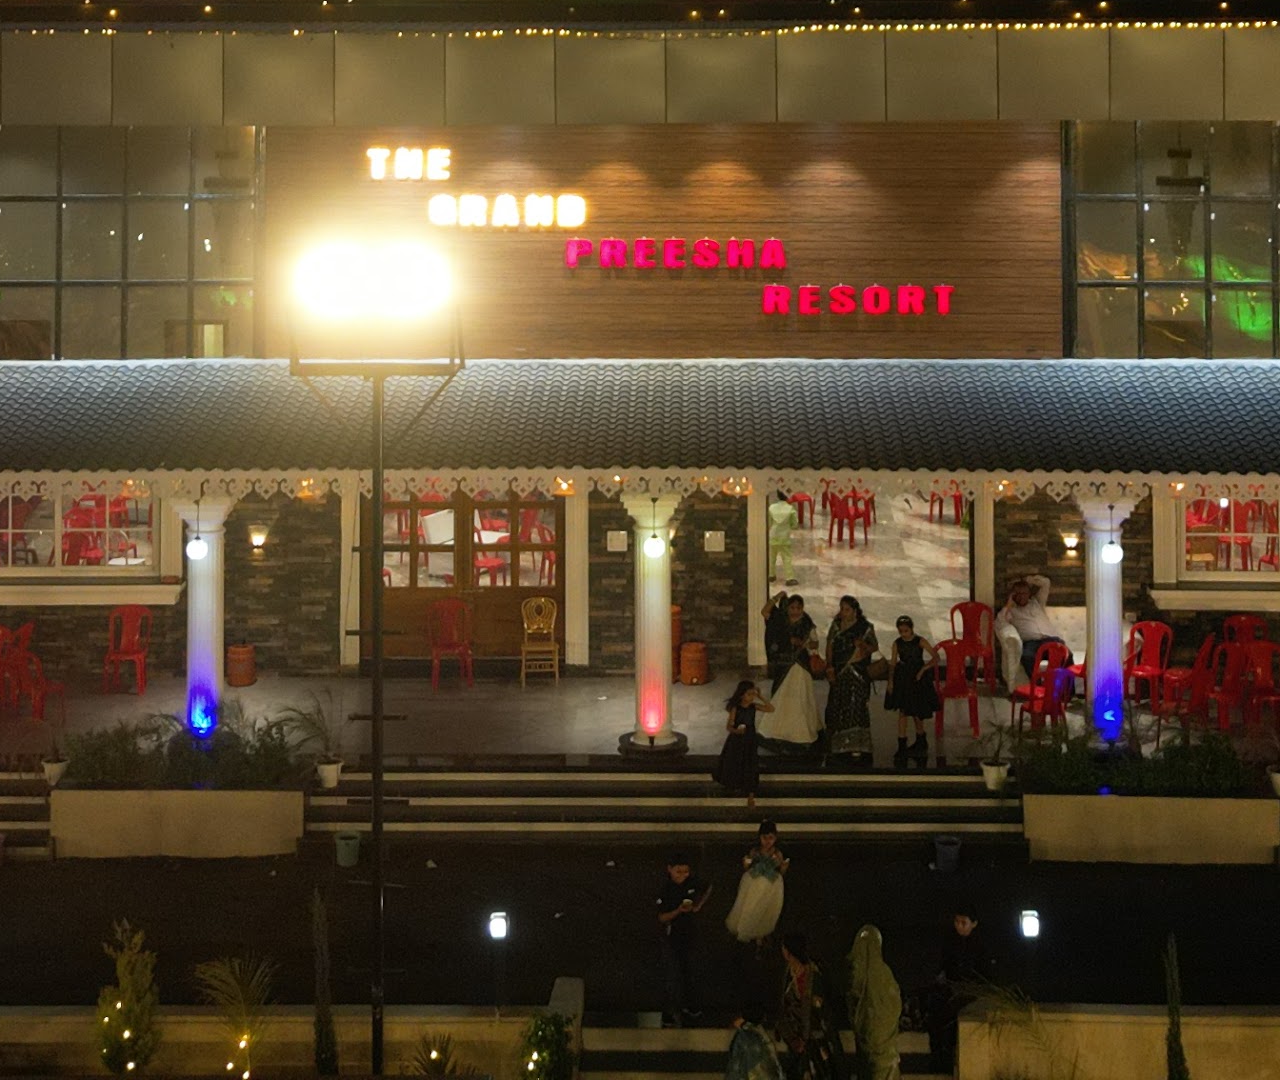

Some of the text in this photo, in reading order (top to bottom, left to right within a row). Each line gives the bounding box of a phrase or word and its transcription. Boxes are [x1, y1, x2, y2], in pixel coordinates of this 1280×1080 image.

[366, 147, 452, 180] THE
[428, 193, 587, 227] GRAND
[565, 238, 787, 269] PREESHA
[762, 284, 954, 315] RESORT
